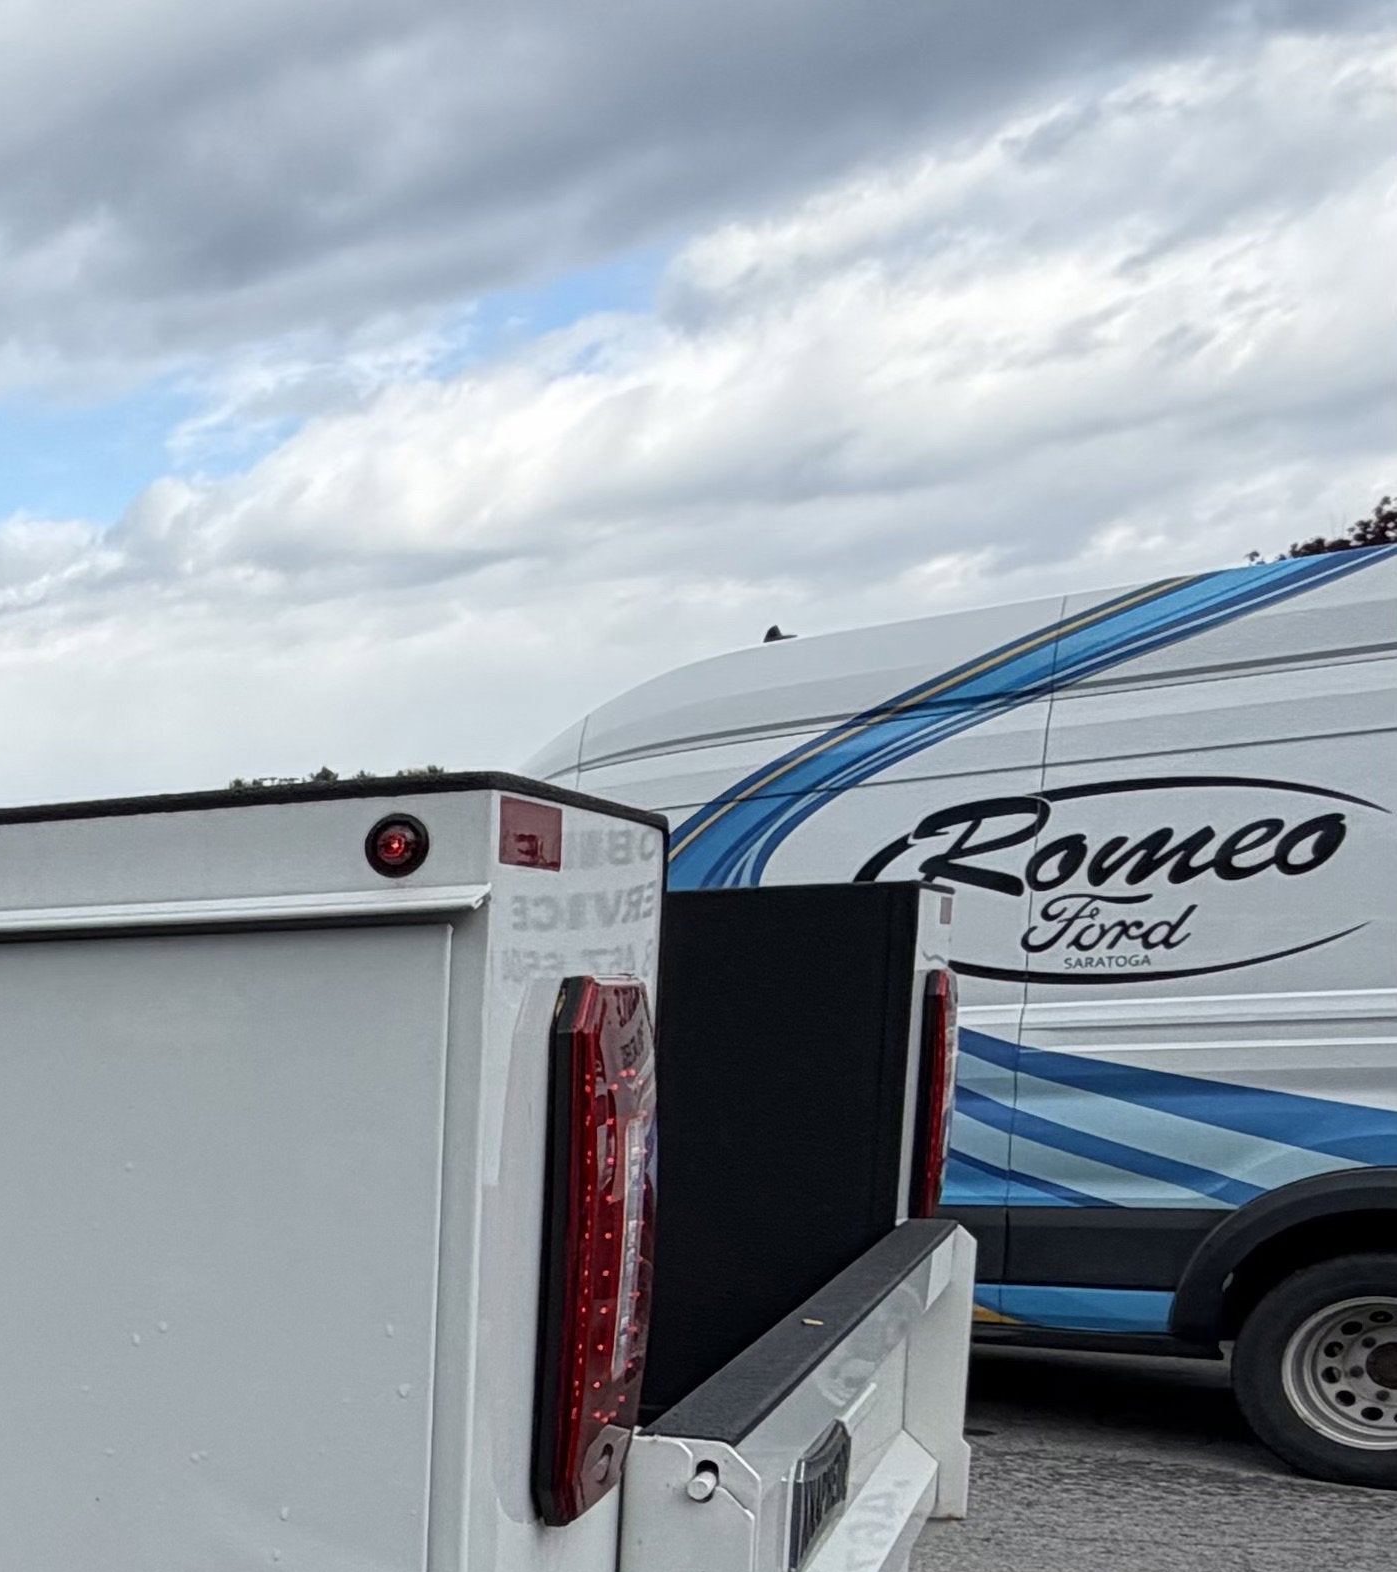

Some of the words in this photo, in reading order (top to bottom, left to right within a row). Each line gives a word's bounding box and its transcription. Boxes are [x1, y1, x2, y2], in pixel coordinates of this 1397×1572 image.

[913, 796, 1346, 897] Romeo
[1021, 893, 1198, 954] Ford
[1063, 953, 1152, 970] SARATOGA
